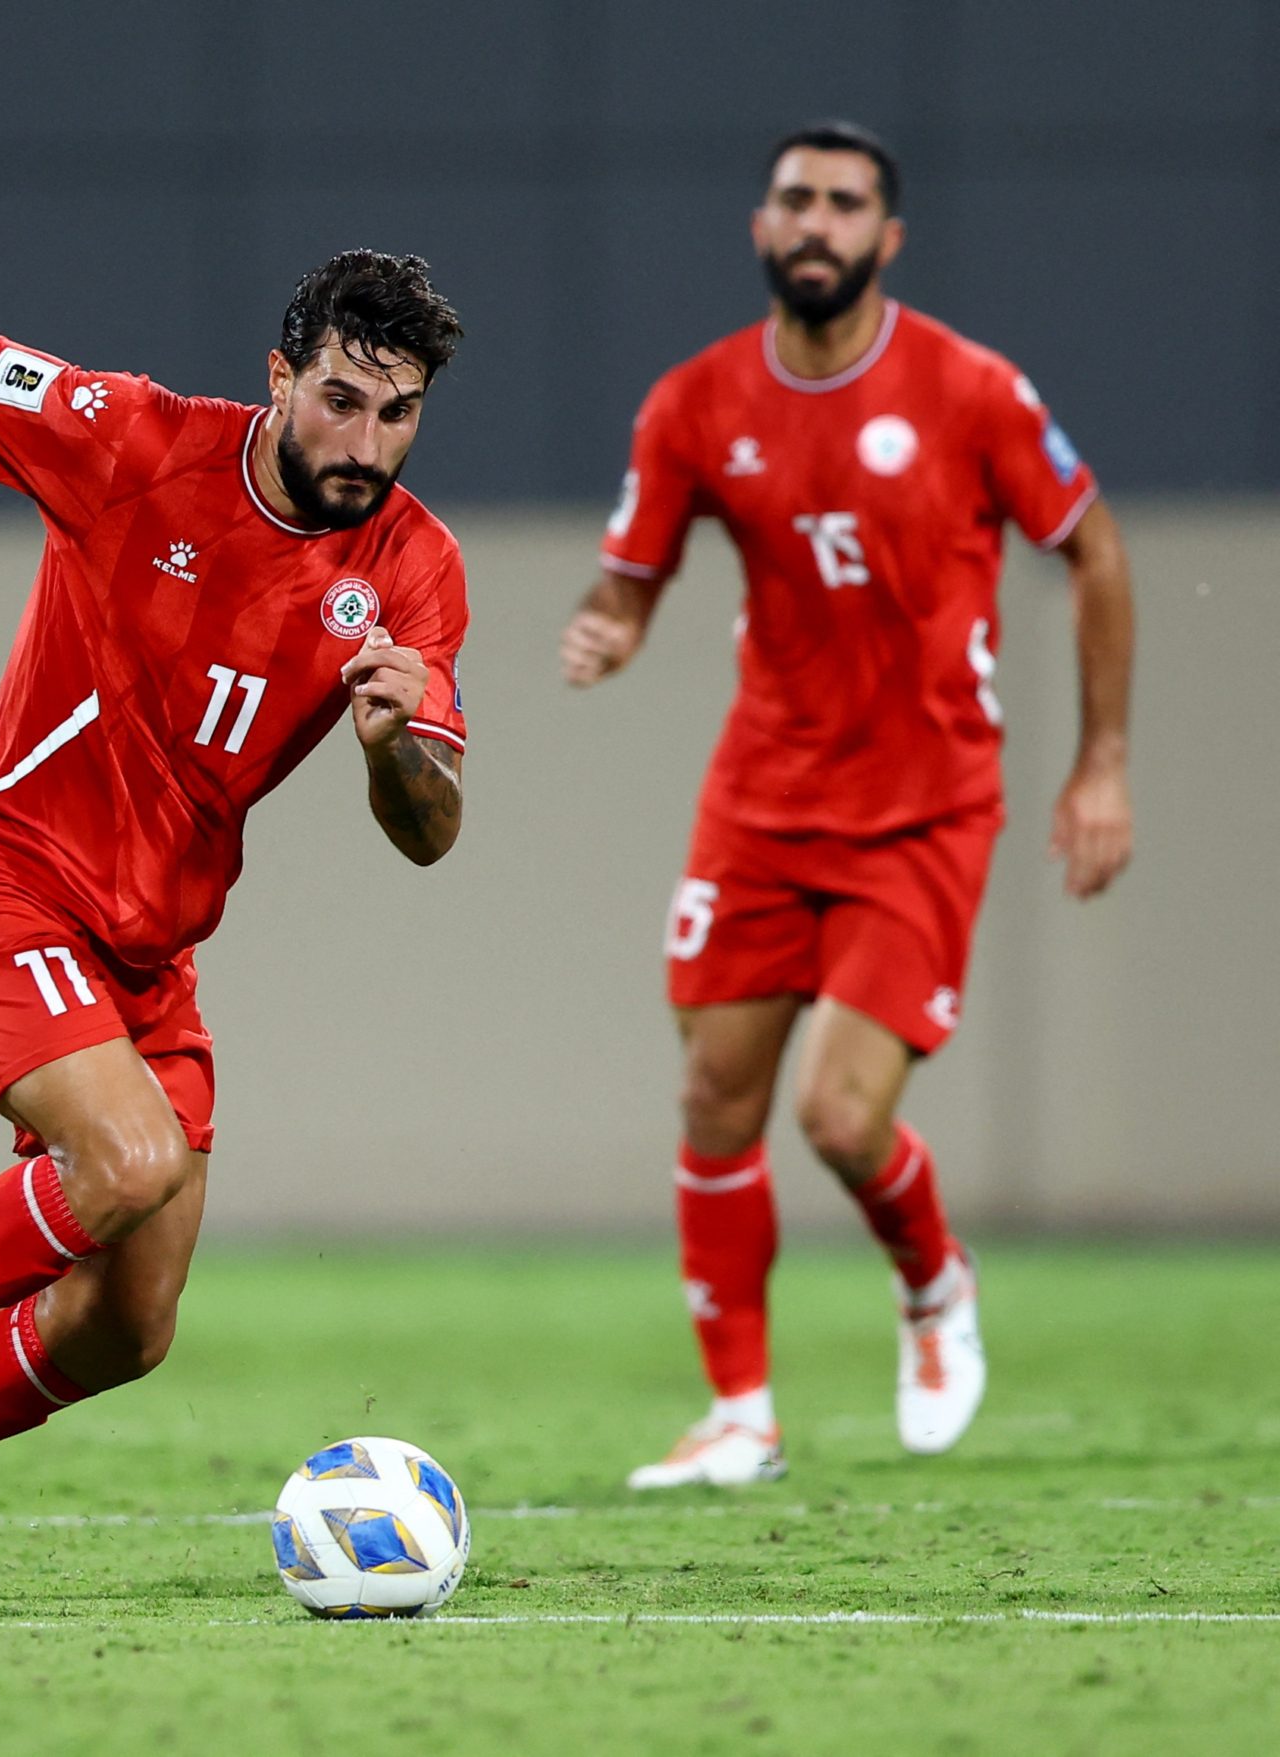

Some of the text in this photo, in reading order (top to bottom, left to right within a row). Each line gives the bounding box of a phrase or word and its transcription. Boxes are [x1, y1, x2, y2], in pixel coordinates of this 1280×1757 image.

[152, 557, 197, 583] KELME
[794, 511, 869, 588] 15
[326, 616, 360, 636] LEBANON
[193, 663, 268, 755] 11
[13, 946, 97, 1017] 11
